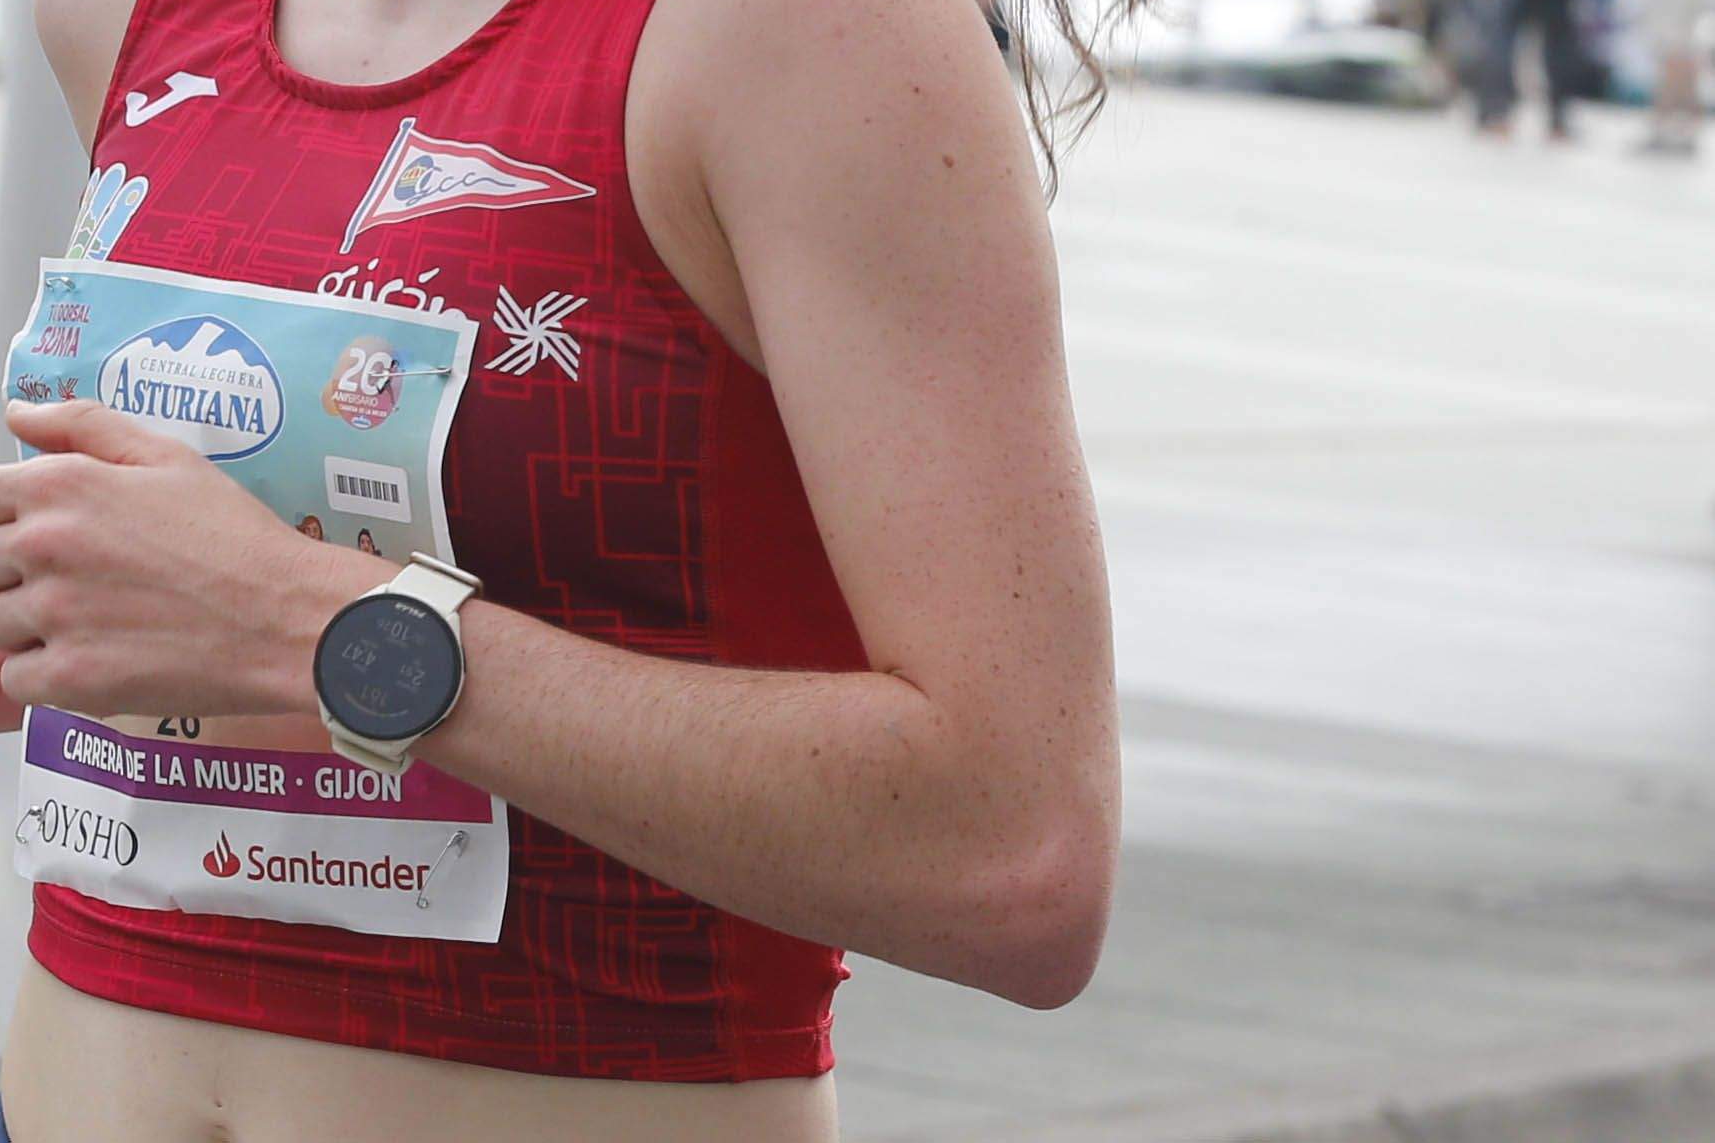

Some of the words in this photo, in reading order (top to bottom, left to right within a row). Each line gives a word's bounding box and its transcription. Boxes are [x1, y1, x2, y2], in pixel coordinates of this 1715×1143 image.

[30, 325, 82, 358] SUMA
[110, 357, 267, 435] ASTURIANA
[140, 357, 197, 378] CENTRAL
[200, 367, 264, 390] LECHERA
[63, 727, 124, 775] CARRERA
[124, 749, 146, 782] DE
[154, 754, 186, 787] LA
[194, 757, 286, 795] MUJER
[41, 798, 139, 866] OYSHO
[247, 844, 431, 891] Santander
